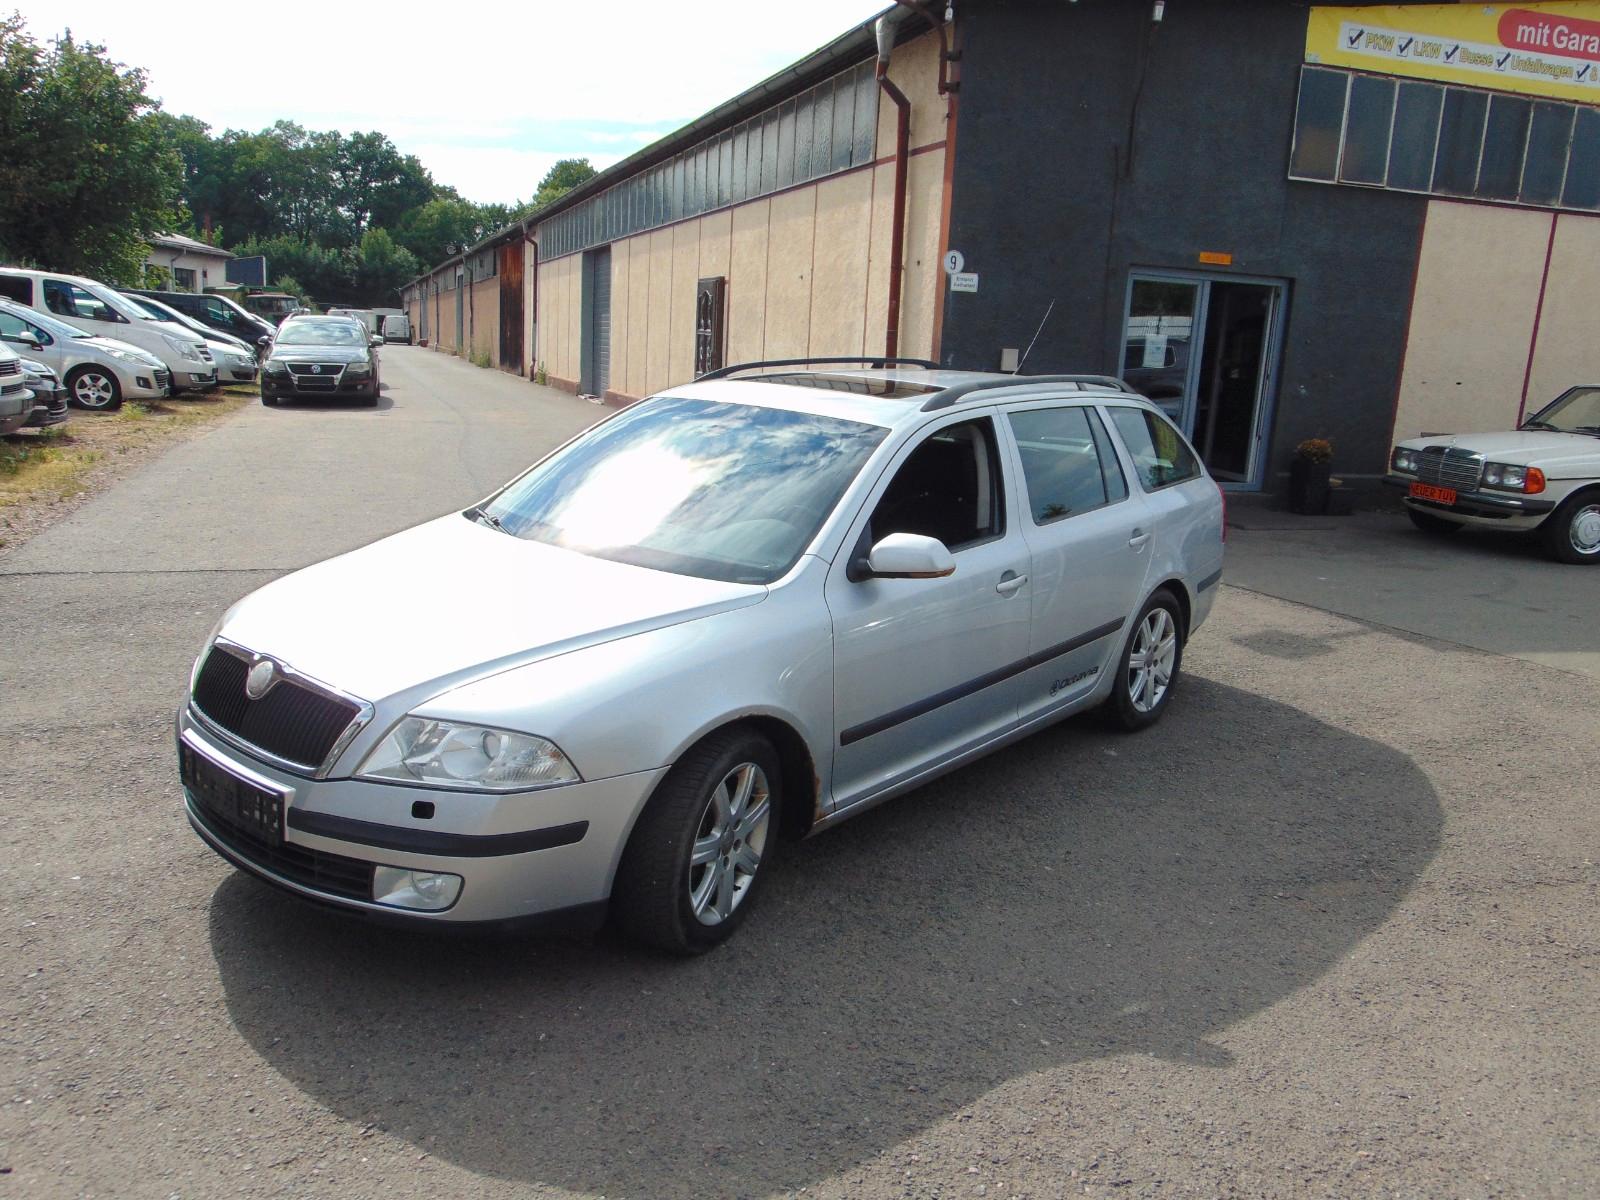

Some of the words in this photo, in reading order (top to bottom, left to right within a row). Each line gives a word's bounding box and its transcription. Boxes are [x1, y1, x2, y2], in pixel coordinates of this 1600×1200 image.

[1365, 32, 1394, 52] PKW
[1413, 40, 1442, 59] LKW
[1459, 47, 1494, 67] Busse
[1515, 22, 1550, 47] mit
[1553, 25, 1600, 54] Gara
[950, 255, 957, 270] 9
